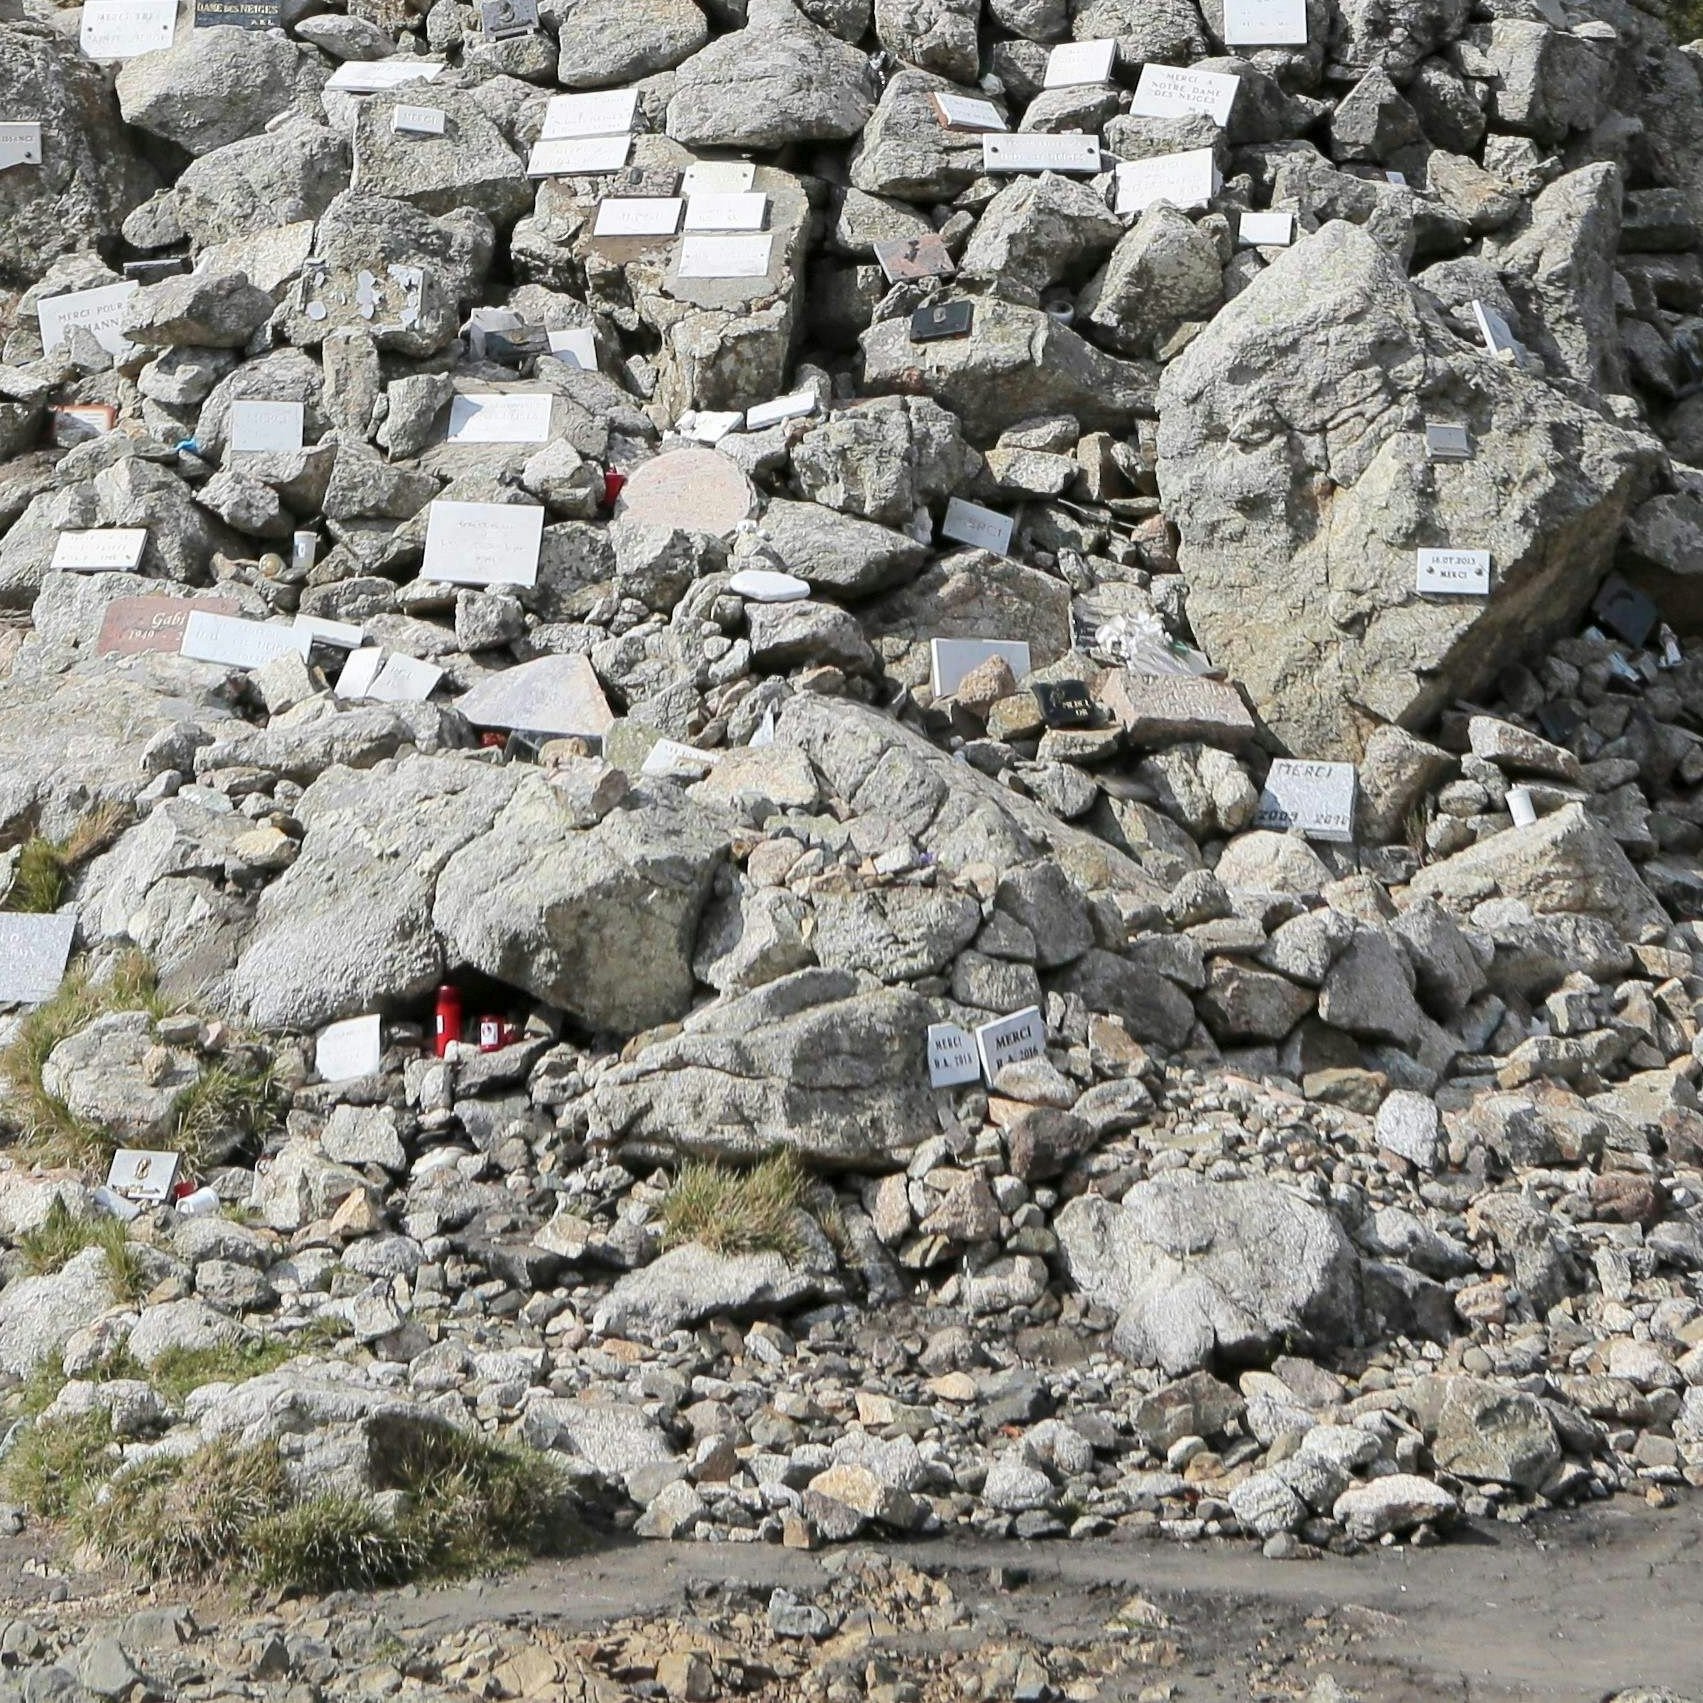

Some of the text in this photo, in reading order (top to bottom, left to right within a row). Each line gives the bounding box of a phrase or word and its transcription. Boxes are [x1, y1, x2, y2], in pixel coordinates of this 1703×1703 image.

[240, 4, 279, 14] NEIGES
[1166, 72, 1199, 84] MERCI
[1151, 80, 1222, 97] NOTRE DAME
[1154, 89, 1216, 104] DES NEIGES
[405, 112, 437, 124] MERCI
[58, 303, 123, 323] MERCI POUR
[1440, 570, 1467, 579] MERCI
[1278, 762, 1332, 777] MERCI
[935, 1036, 962, 1050] MERCI
[995, 1024, 1032, 1050] MERCI
